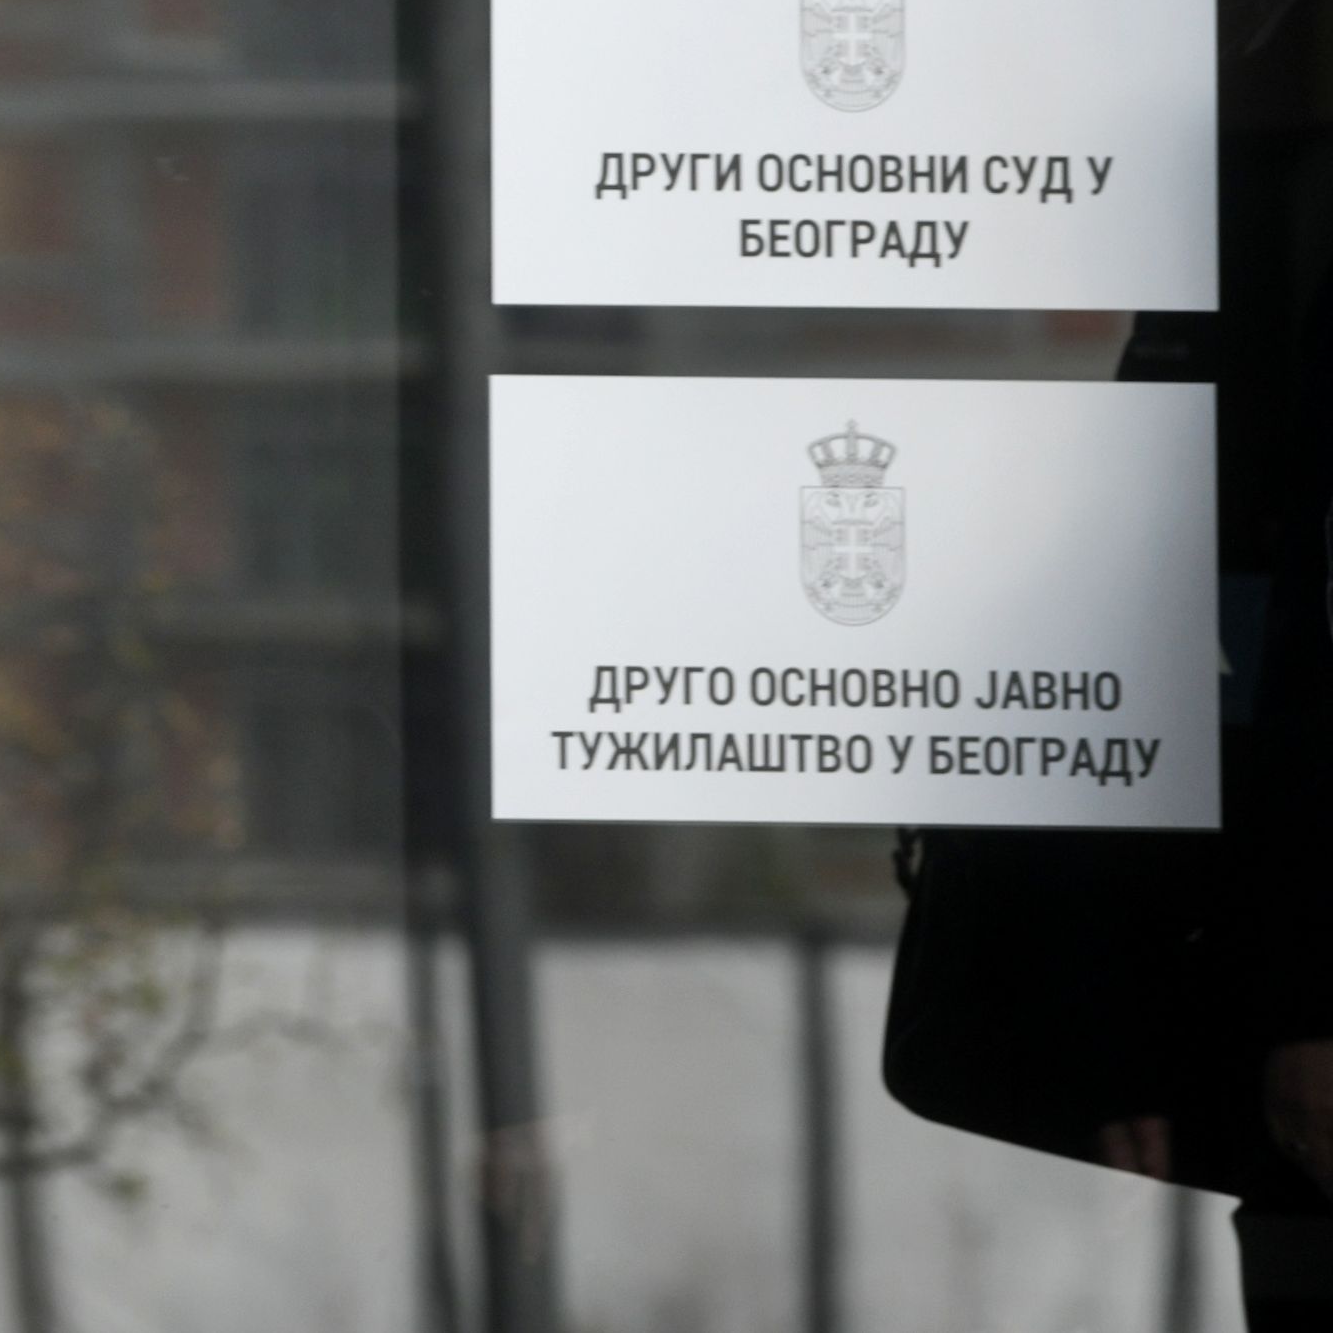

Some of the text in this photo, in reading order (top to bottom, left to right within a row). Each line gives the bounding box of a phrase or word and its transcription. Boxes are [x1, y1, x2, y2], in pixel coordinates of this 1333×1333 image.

[595, 152, 1114, 204] ДРУГИ ОСНОВНИ СУД У
[740, 218, 970, 269] БЕОГРАДУ
[588, 666, 1123, 712] ДРУГО ОСНОВНО ЈАВНО
[551, 731, 1162, 785] ТУЖИЛАШТВО У БЕОГРАДУ
